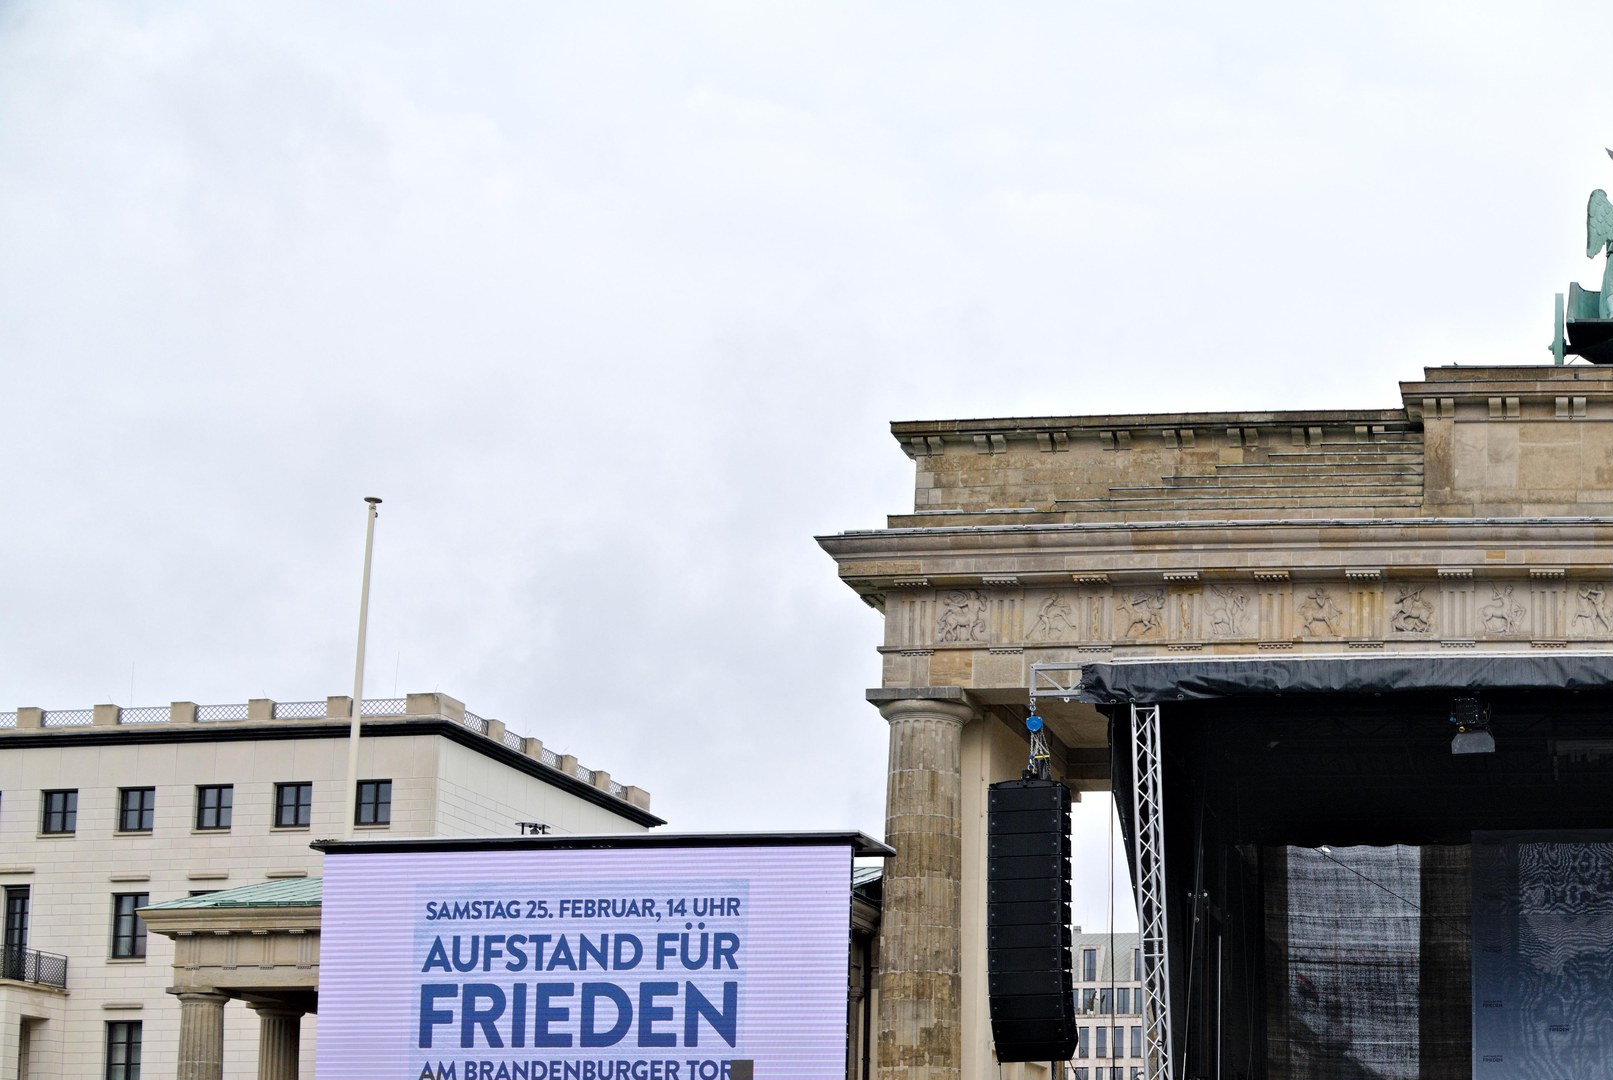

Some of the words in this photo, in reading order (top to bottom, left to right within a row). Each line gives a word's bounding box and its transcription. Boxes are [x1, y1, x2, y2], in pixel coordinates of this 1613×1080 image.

[425, 899, 521, 921] SAMSTAG
[525, 900, 554, 920] 25.
[559, 898, 662, 924] FEBRUAR,
[666, 899, 687, 917] 14
[693, 897, 741, 917] UHR
[421, 934, 643, 973] AUFSTAND
[656, 922, 740, 970] FÜR
[418, 980, 737, 1048] FRIEDEN
